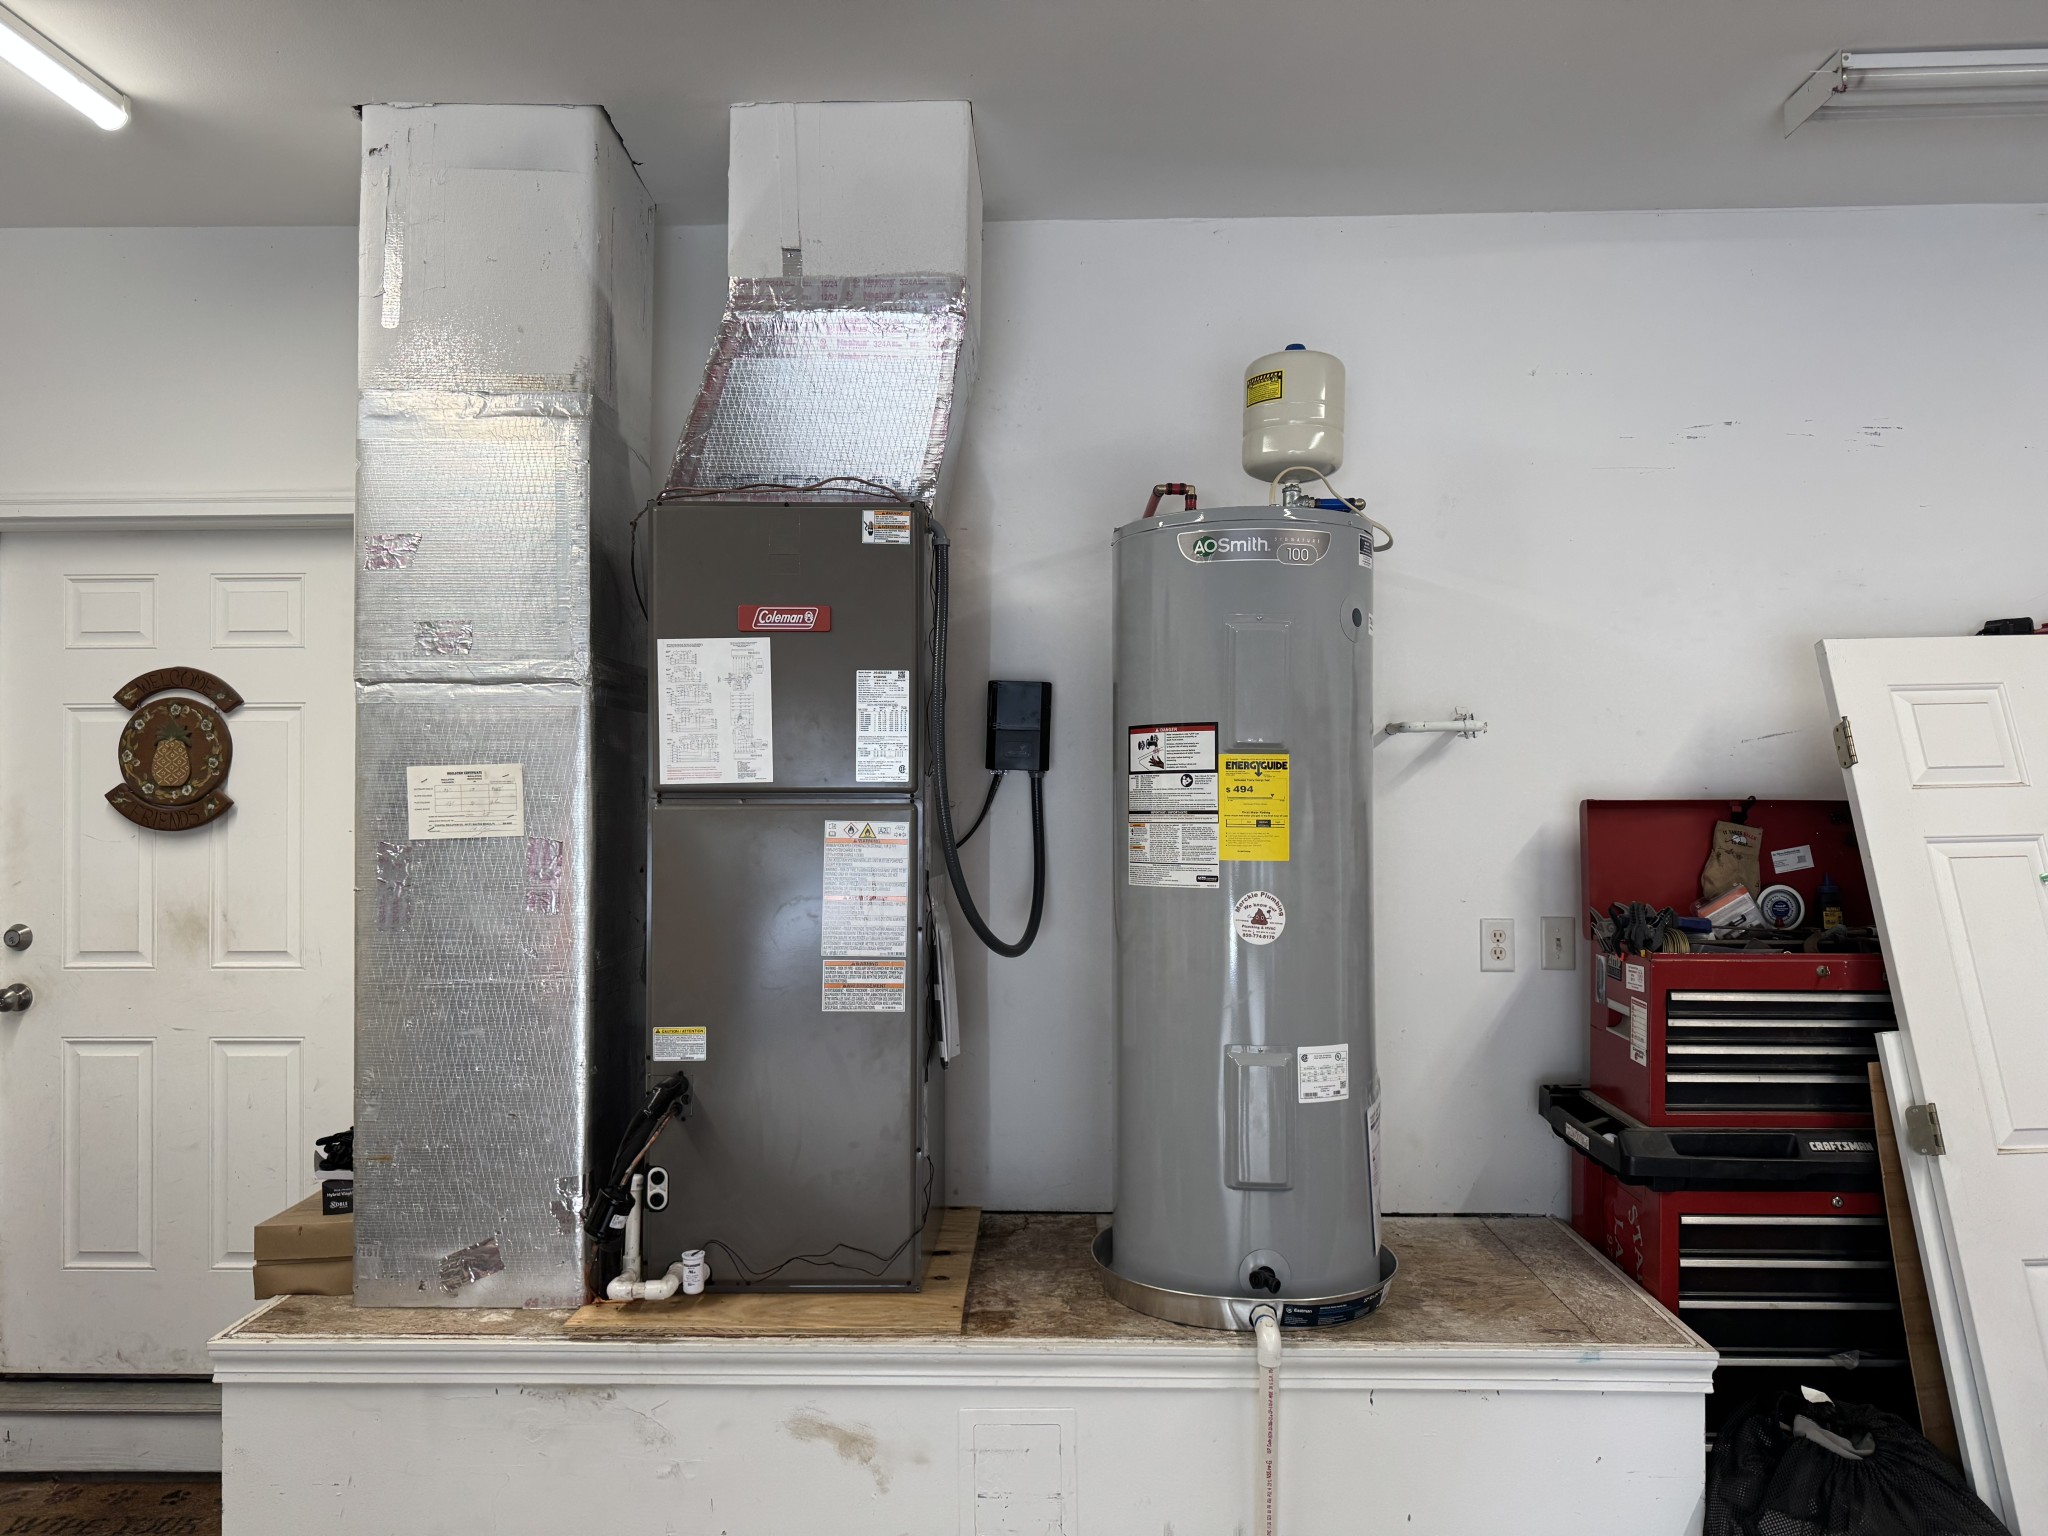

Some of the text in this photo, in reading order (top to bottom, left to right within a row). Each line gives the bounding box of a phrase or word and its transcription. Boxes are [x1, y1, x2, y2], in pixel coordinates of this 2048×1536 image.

[821, 280, 838, 288] 12/24
[821, 293, 838, 301] 12/24
[873, 340, 893, 348] 324A
[1287, 547, 1309, 561] 100
[758, 609, 804, 624] Coleman
[136, 670, 217, 697] WELCOME
[1233, 785, 1254, 793] 494
[131, 804, 200, 830] FRIENDS
[1260, 891, 1284, 917] Plumbing
[1808, 1141, 1874, 1151] CRAFTSMAN
